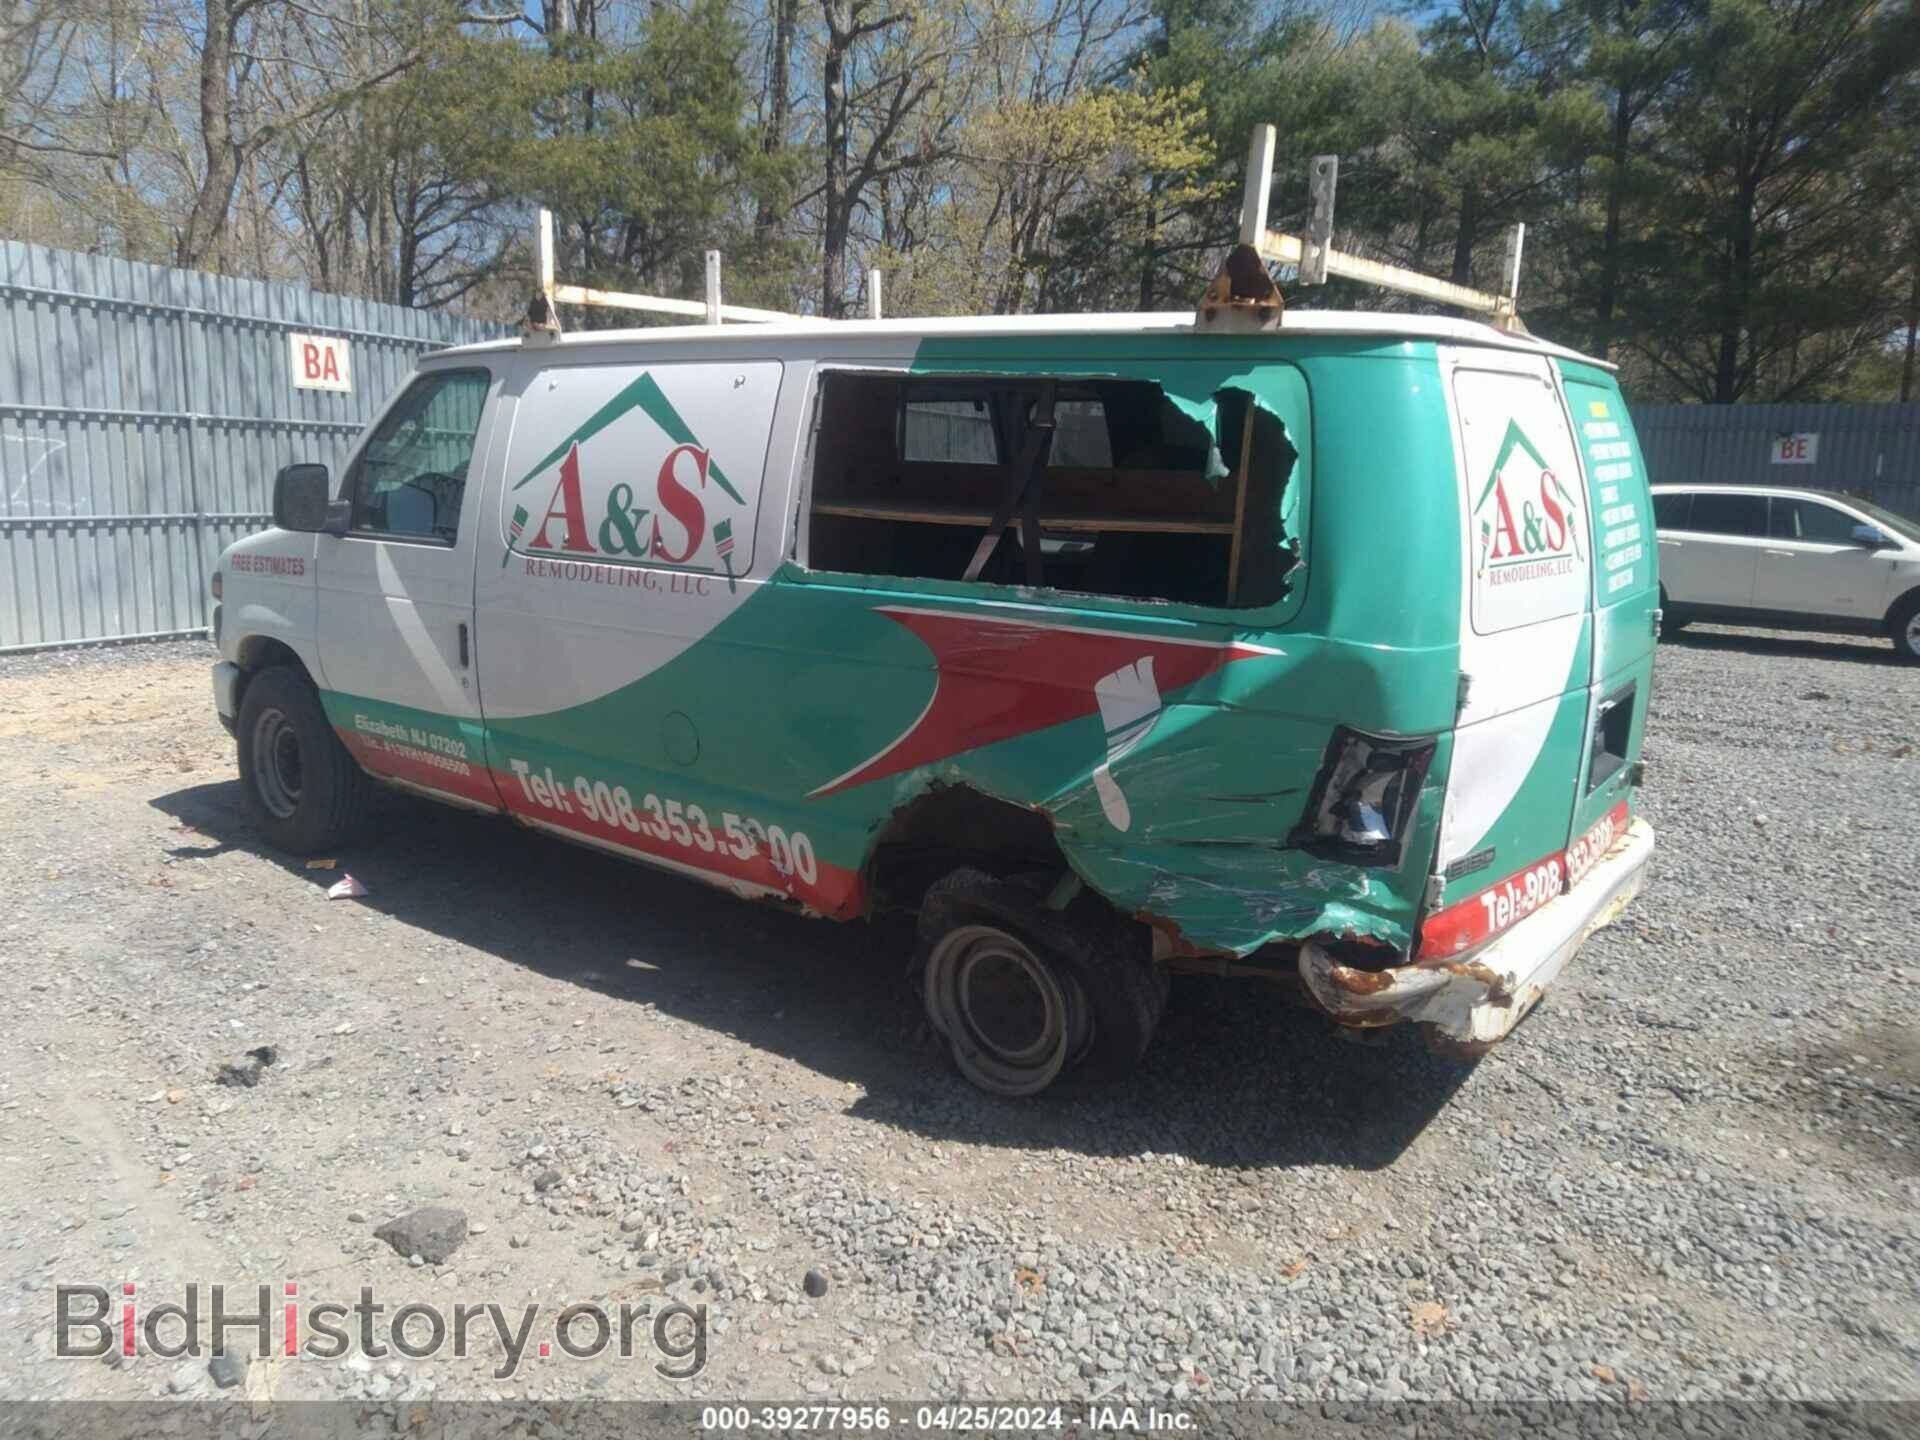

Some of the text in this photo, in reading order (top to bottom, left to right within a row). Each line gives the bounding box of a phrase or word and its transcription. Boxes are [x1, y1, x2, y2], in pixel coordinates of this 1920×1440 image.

[303, 343, 340, 381] BA
[1781, 439, 1809, 459] BE
[528, 442, 710, 564] A&S
[1490, 471, 1566, 560] A&S
[231, 553, 304, 576] FREE ESTIMATES
[525, 558, 711, 597] REMODELING, LLC
[1557, 558, 1573, 576] LLC
